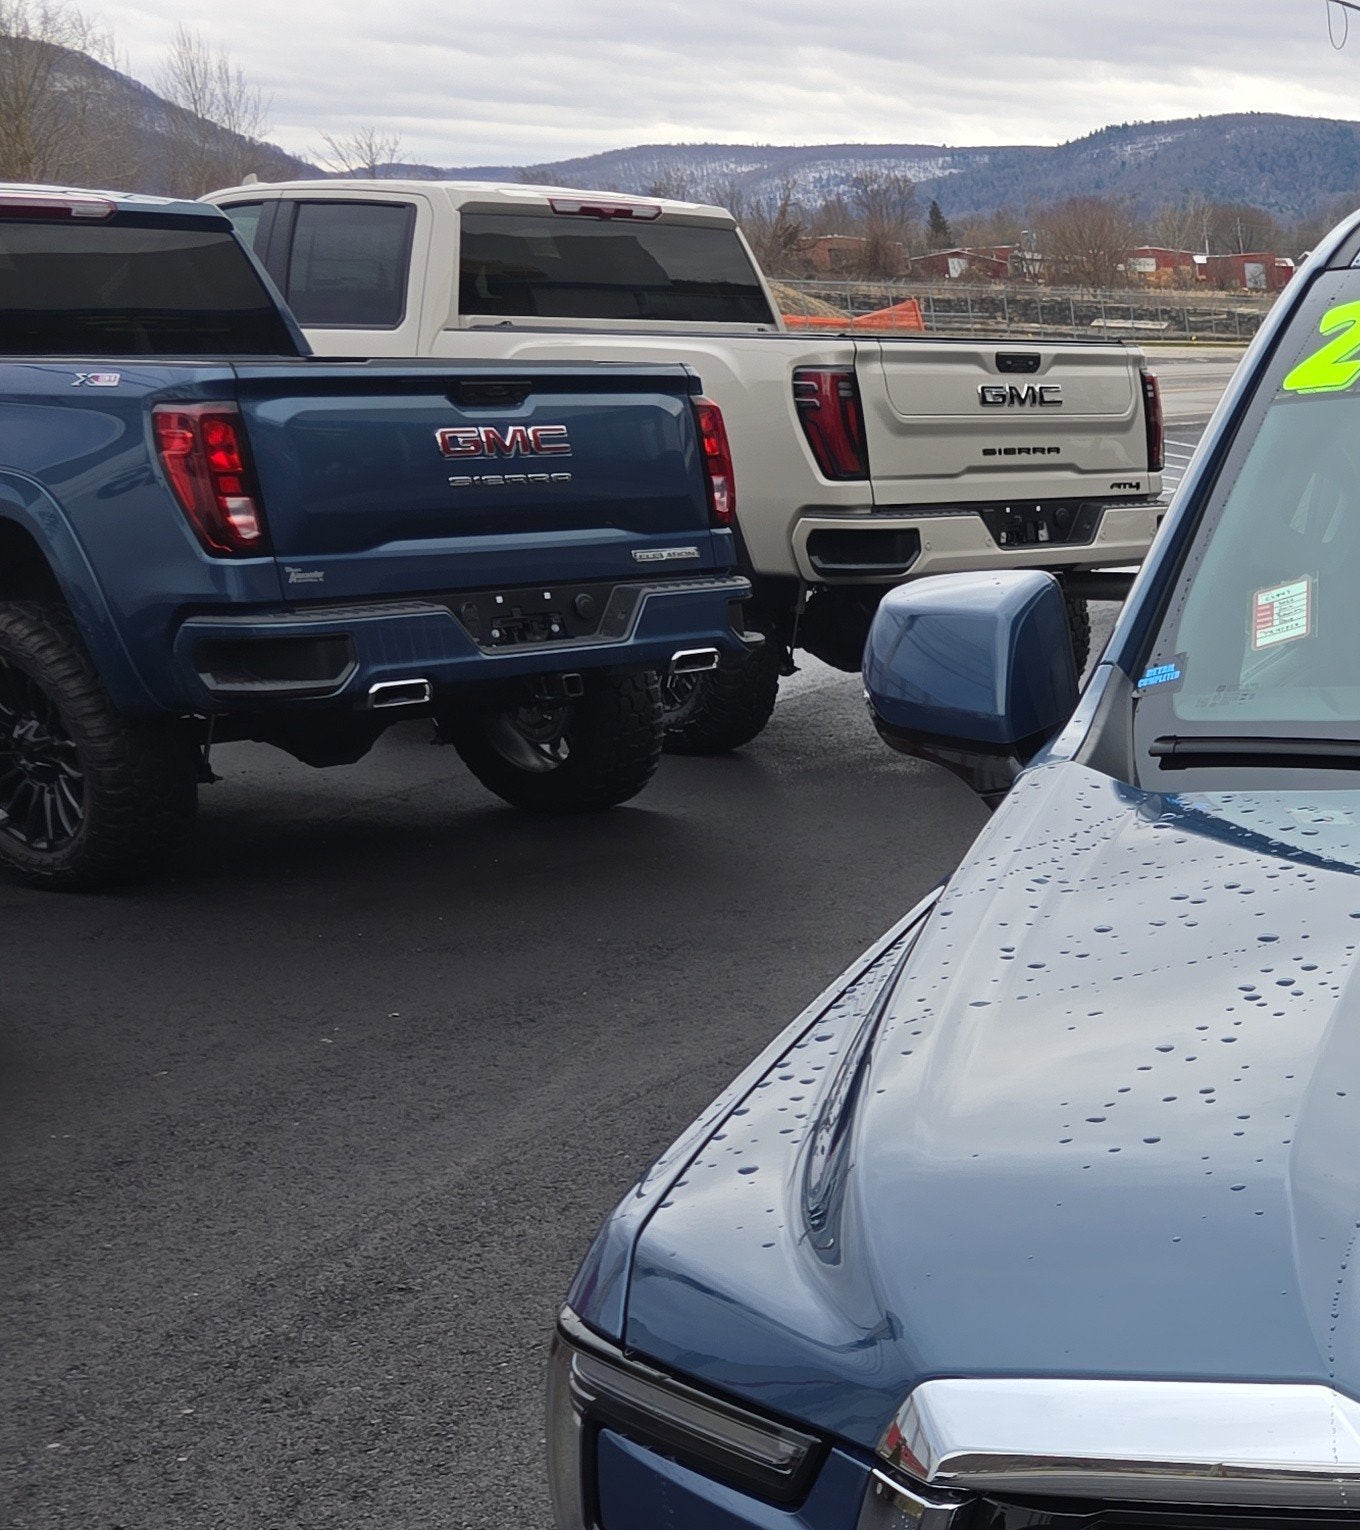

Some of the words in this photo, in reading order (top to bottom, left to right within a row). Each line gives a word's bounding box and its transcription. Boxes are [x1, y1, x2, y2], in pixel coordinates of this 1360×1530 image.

[977, 383, 1064, 408] GMC
[434, 424, 573, 460] GMC
[982, 446, 1061, 457] SIERRA
[448, 472, 573, 487] SIERRA
[1109, 481, 1141, 491] AT4
